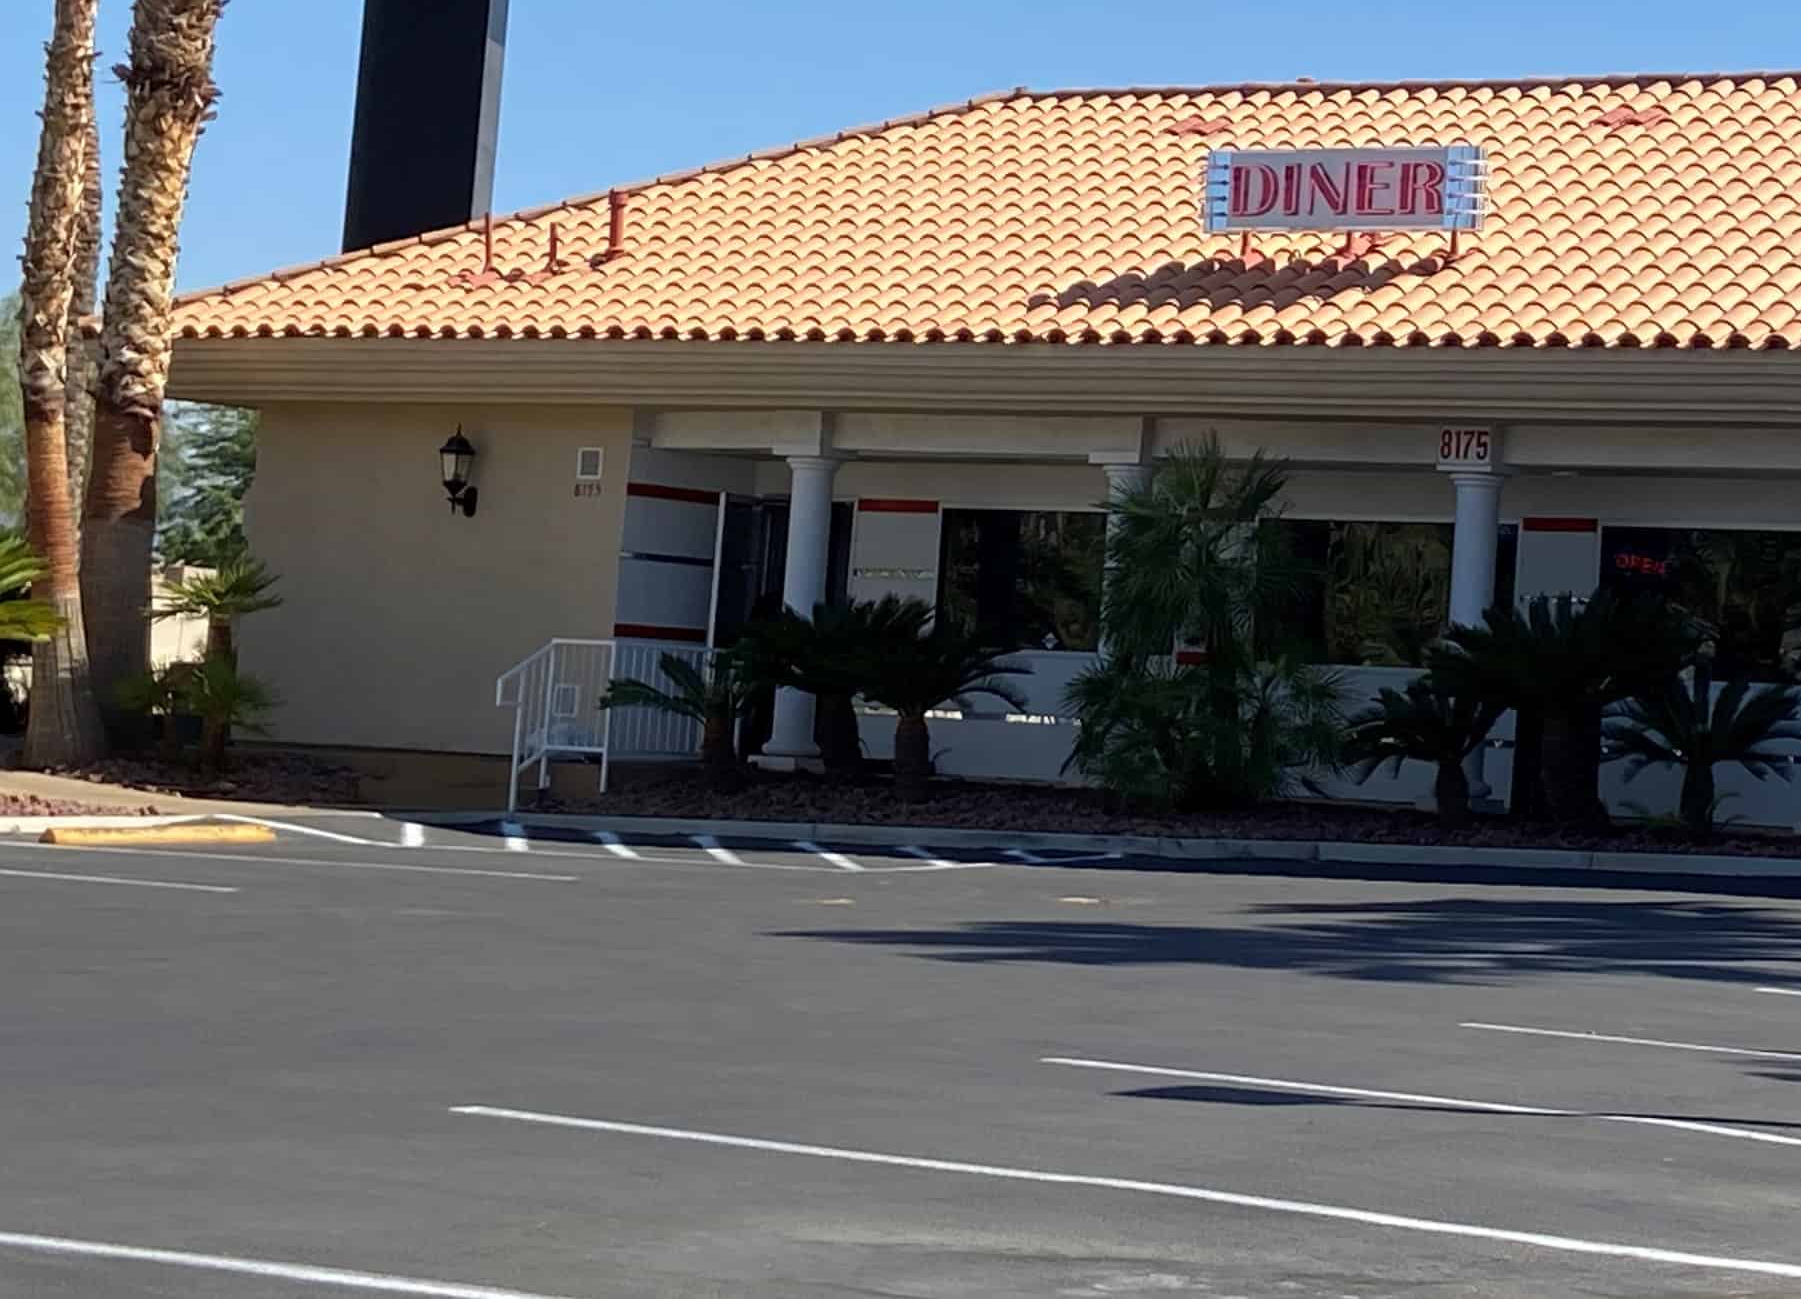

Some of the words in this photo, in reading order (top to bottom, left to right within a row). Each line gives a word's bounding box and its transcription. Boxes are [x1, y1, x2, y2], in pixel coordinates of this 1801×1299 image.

[1231, 161, 1445, 216] DINER
[1440, 430, 1488, 459] 8175
[1615, 552, 1671, 575] OPEN
